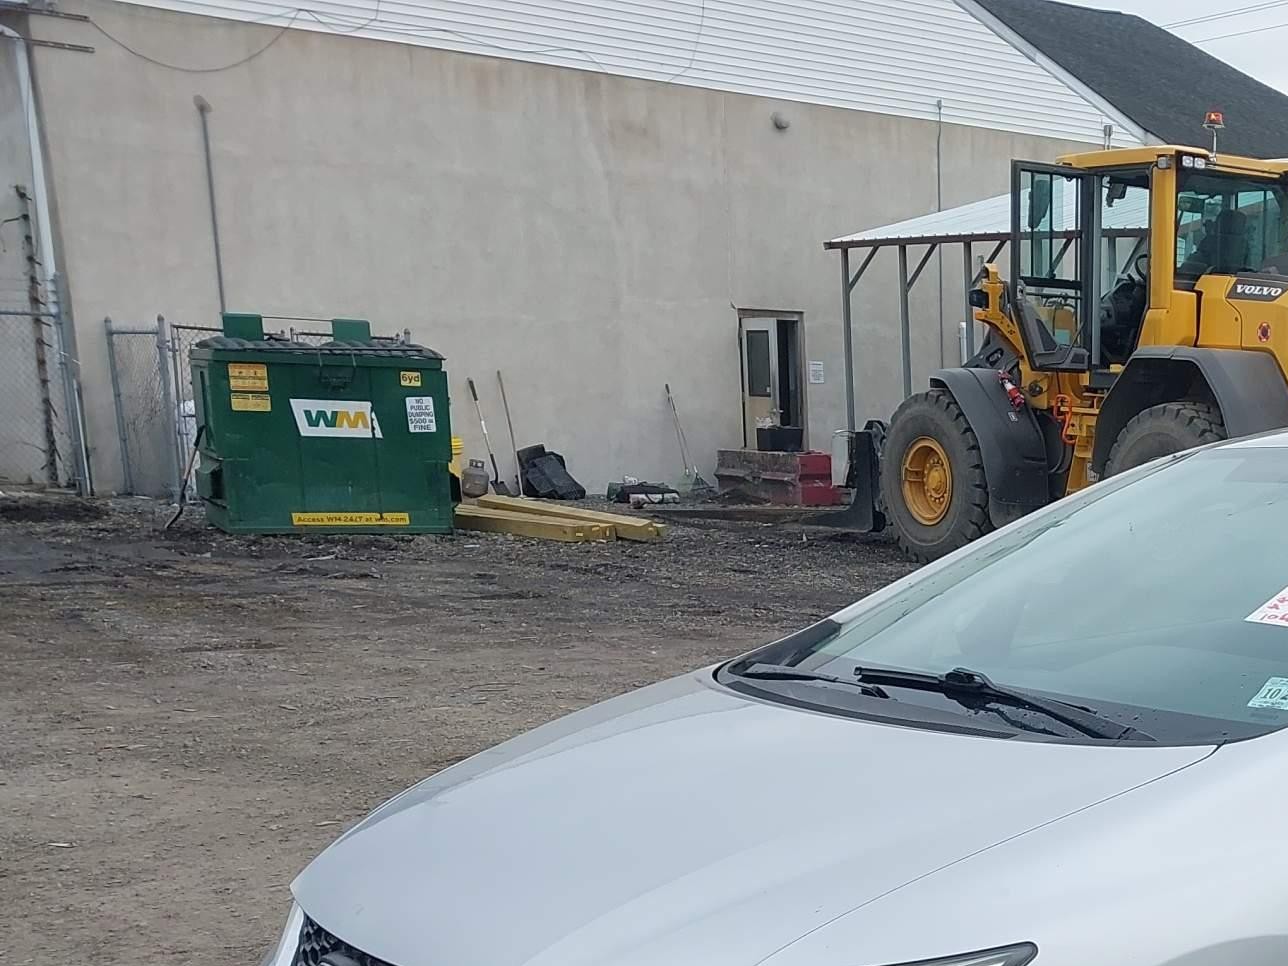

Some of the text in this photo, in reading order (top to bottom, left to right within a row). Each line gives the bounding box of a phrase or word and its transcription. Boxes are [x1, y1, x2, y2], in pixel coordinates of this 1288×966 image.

[1236, 284, 1282, 296] VOLVO
[401, 374, 420, 383] 6yd
[303, 409, 370, 429] WM
[296, 515, 324, 523] Access
[1260, 687, 1282, 699] 10
